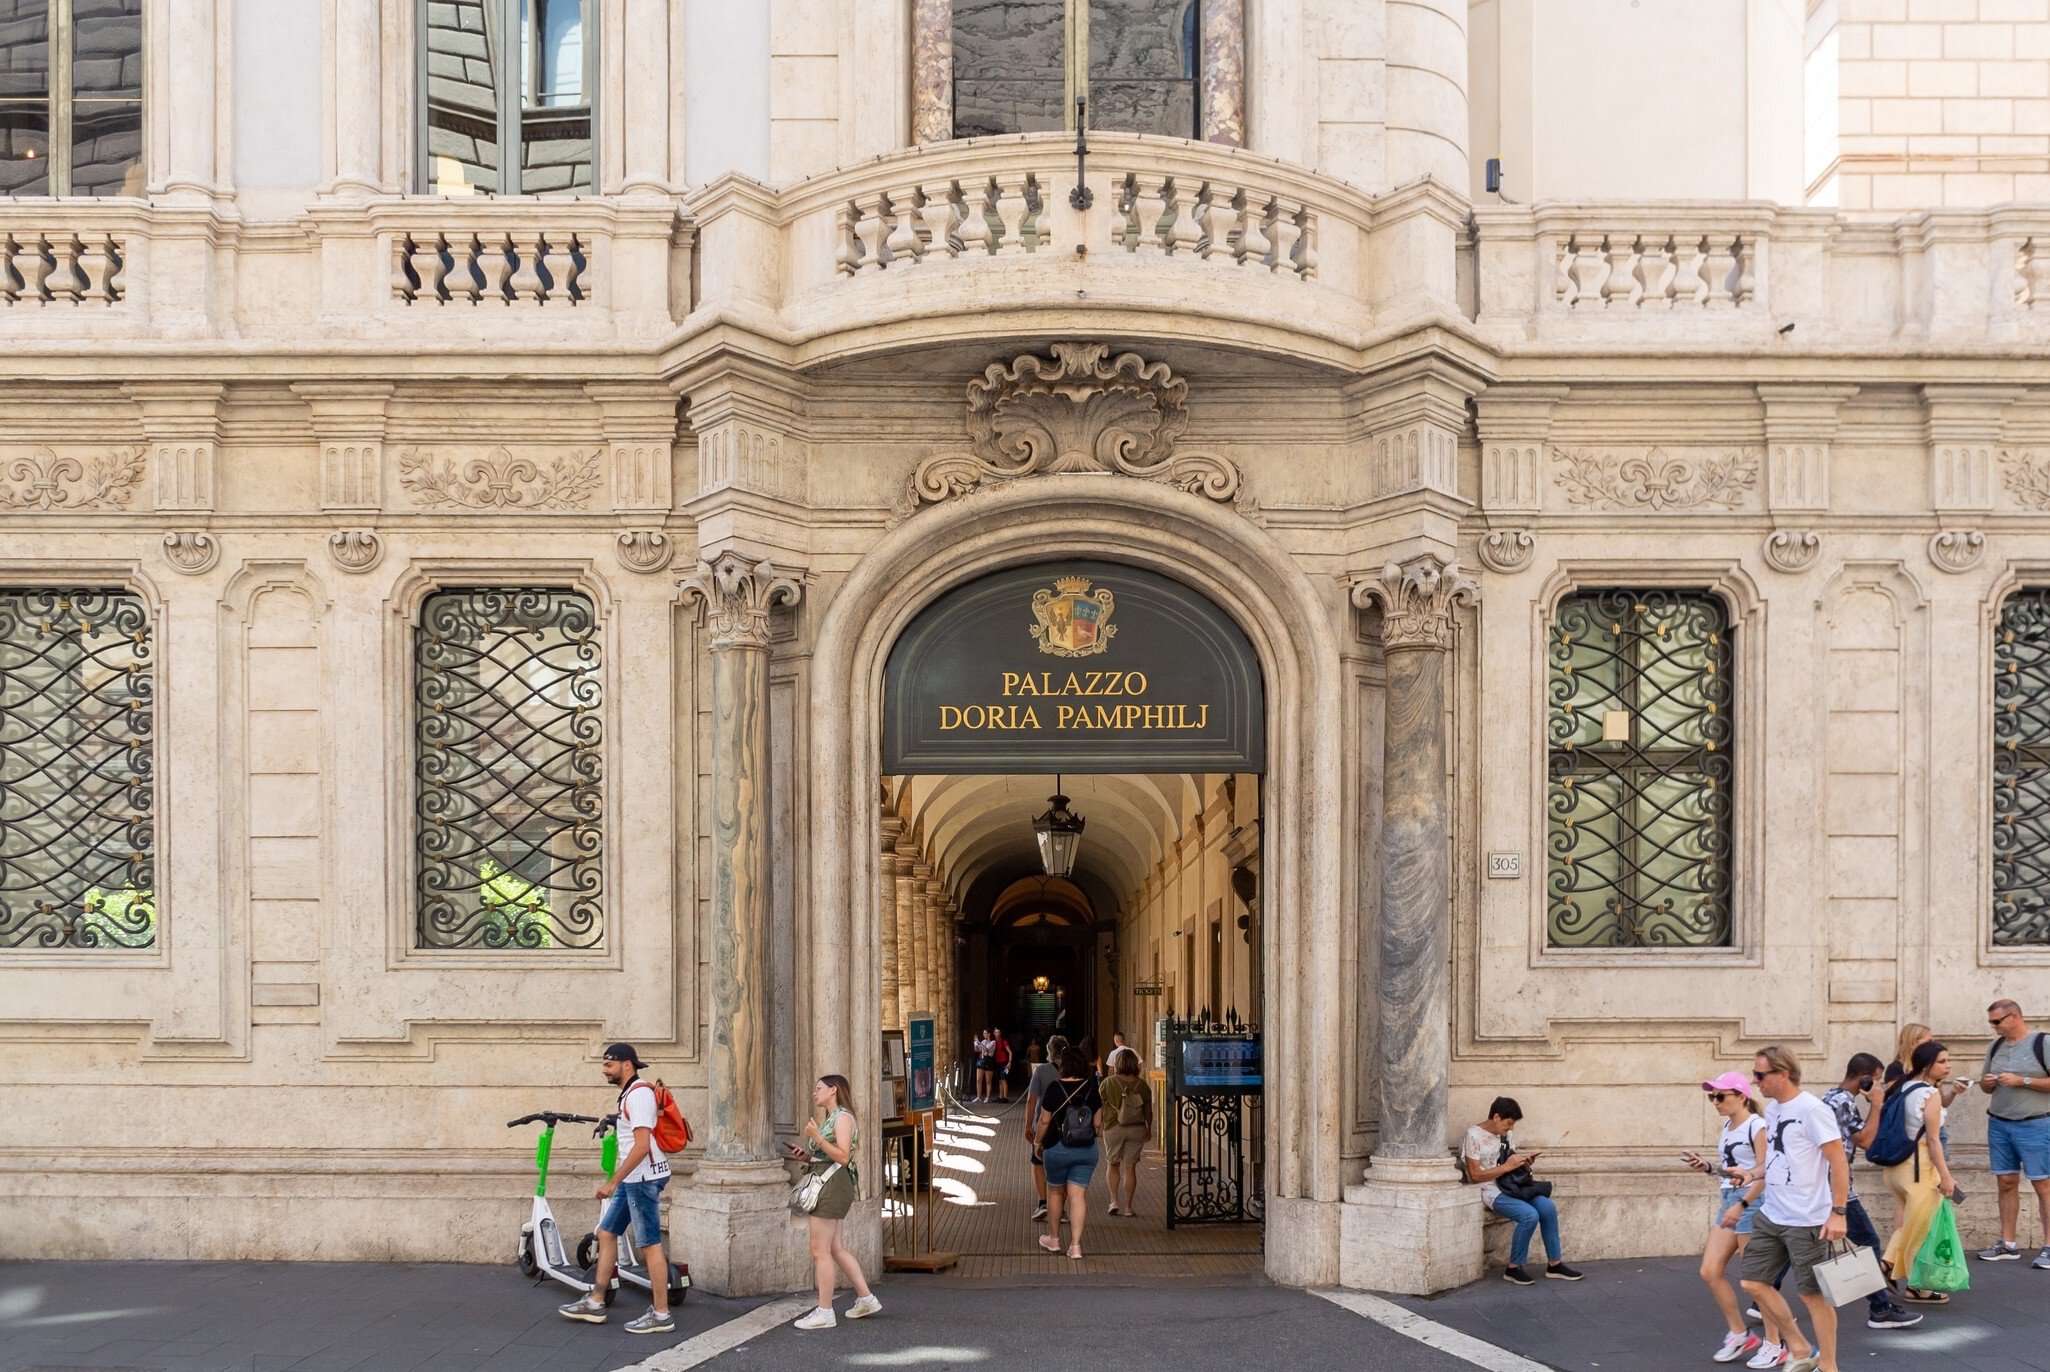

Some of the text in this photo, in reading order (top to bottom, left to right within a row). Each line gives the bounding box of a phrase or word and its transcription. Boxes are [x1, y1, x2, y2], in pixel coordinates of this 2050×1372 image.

[1001, 671, 1148, 697] PALAZZO
[938, 704, 1210, 730] DORIA PAMPHILJ
[1492, 857, 1518, 871] 305
